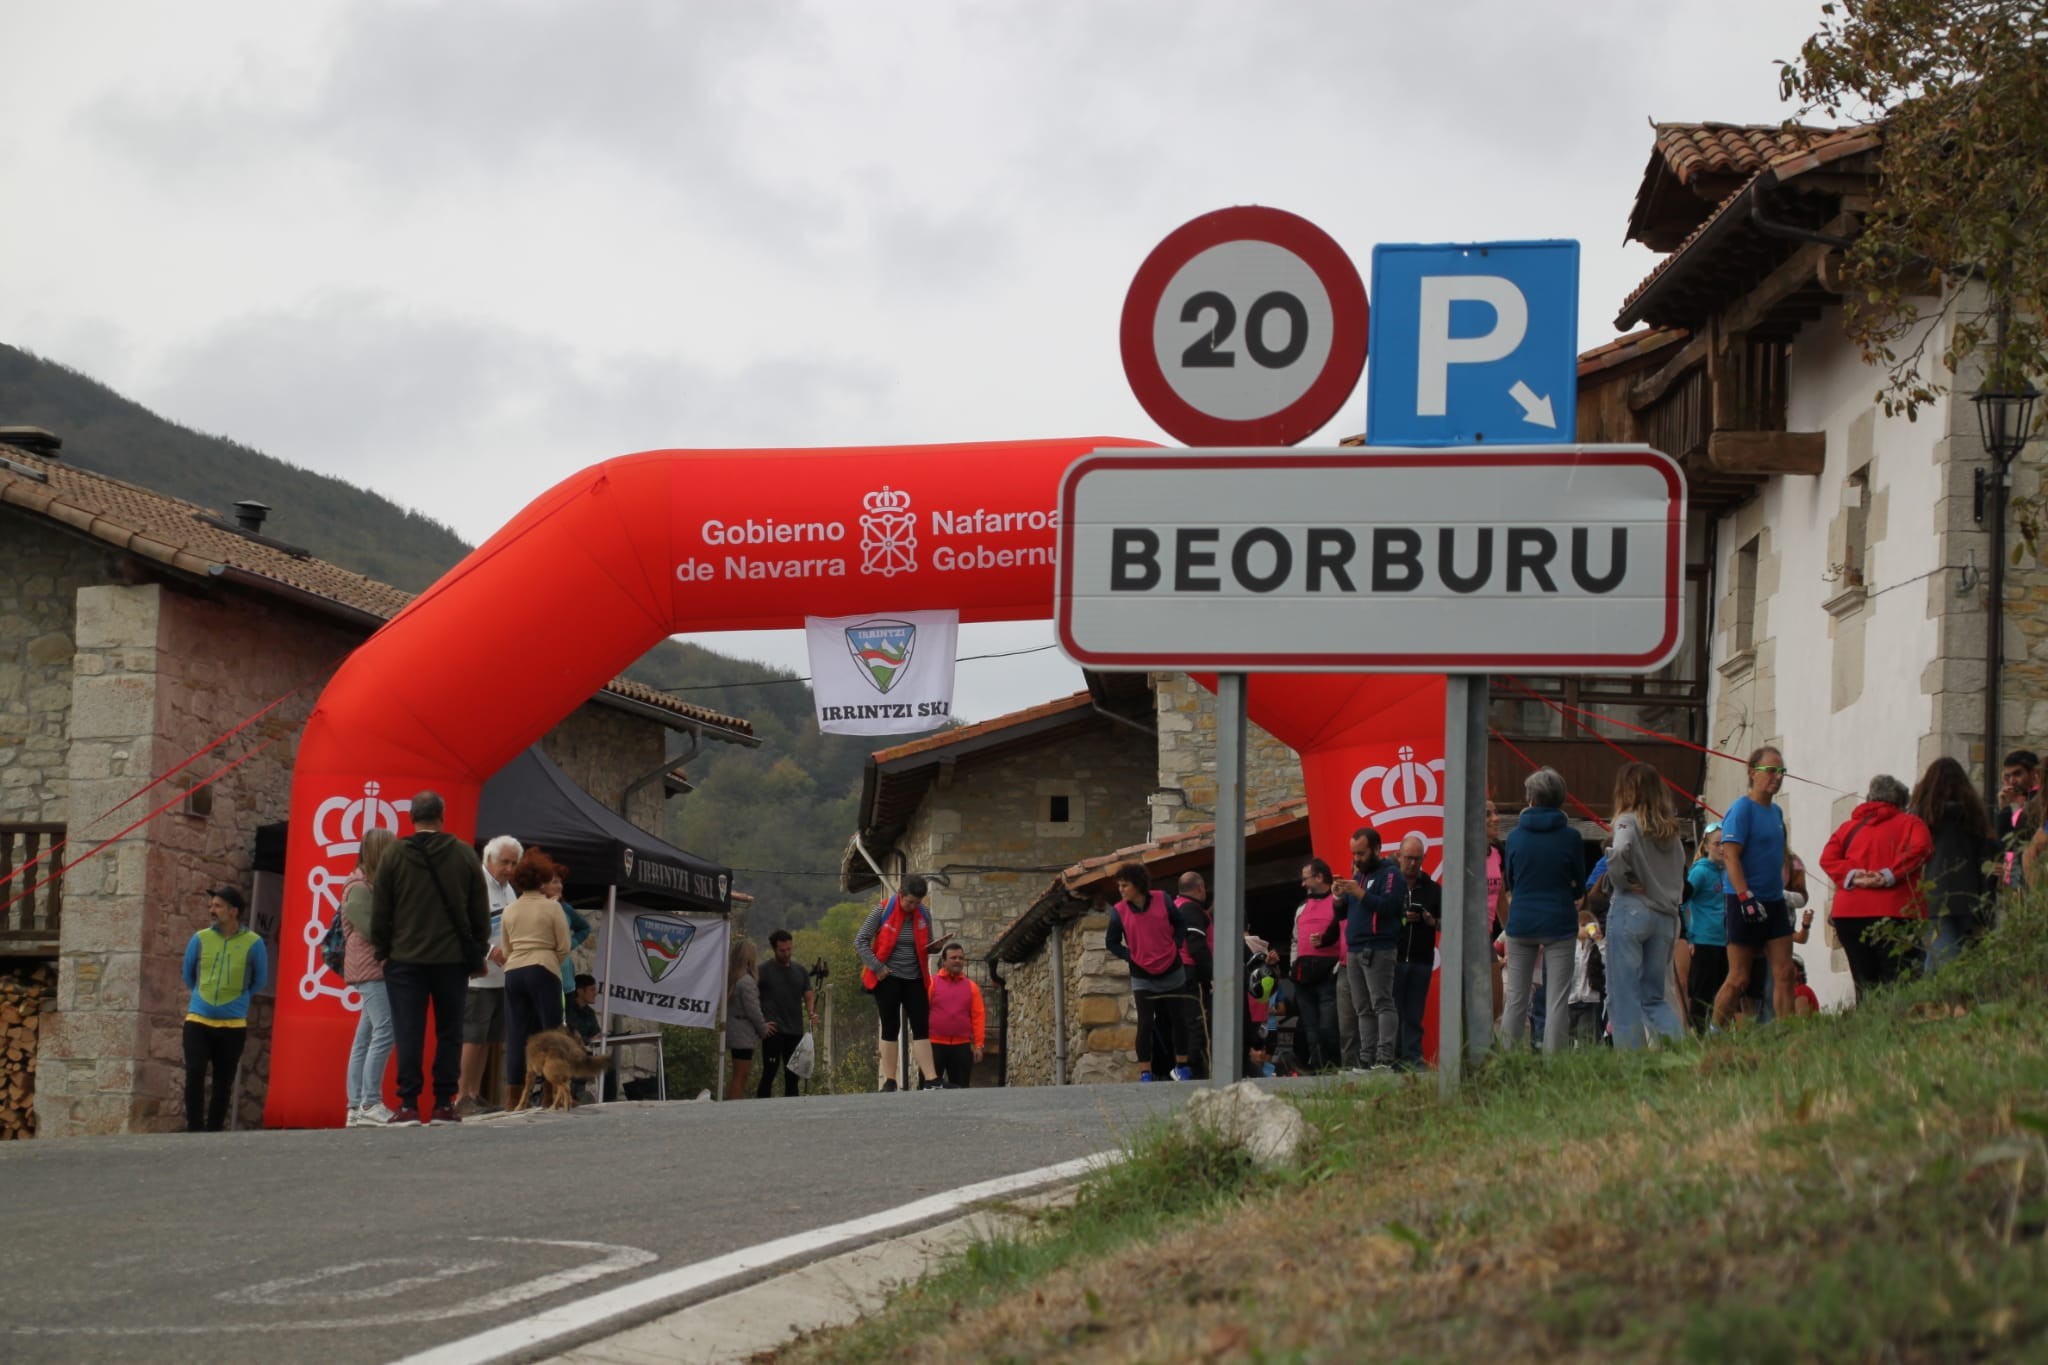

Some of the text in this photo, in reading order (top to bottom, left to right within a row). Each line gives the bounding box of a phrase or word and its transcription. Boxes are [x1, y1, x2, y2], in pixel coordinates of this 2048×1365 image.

[1179, 291, 1309, 369] 20
[1417, 275, 1529, 416] P
[701, 518, 845, 545] Gobierno
[932, 508, 1058, 536] Nafarroa
[676, 556, 846, 582] de Navarra
[1111, 527, 1628, 593] BEORBURU
[858, 628, 905, 639] IRRINTZI
[822, 701, 949, 721] IRRINTZI SKI
[638, 860, 714, 899] IRRINTZI SKI
[677, 997, 711, 1013] SKI
